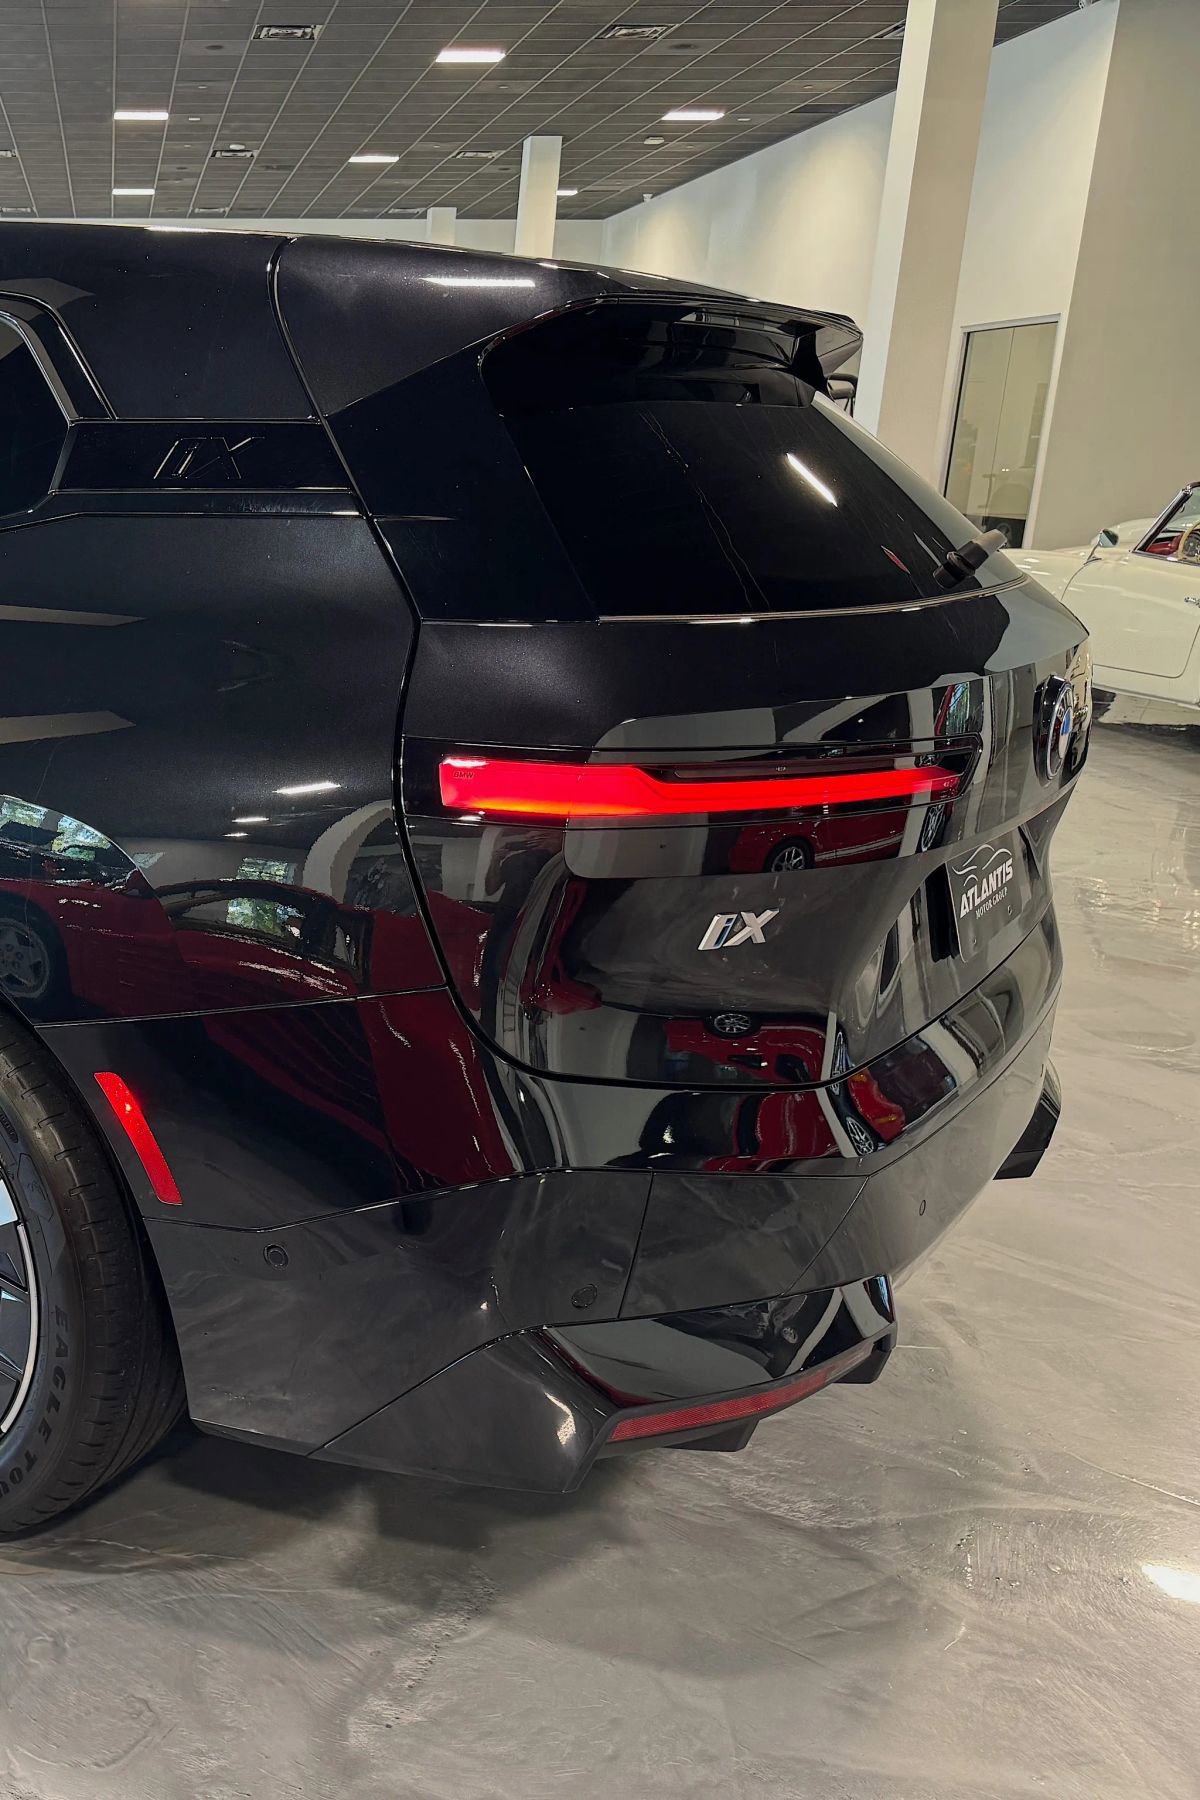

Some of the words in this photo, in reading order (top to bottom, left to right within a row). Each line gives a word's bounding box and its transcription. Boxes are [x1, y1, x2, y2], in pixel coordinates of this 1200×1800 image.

[960, 857, 1014, 919] ATLANTIS
[975, 899, 993, 920] MOTOR
[992, 886, 1008, 905] GROUP
[37, 1304, 69, 1444] EAGLE
